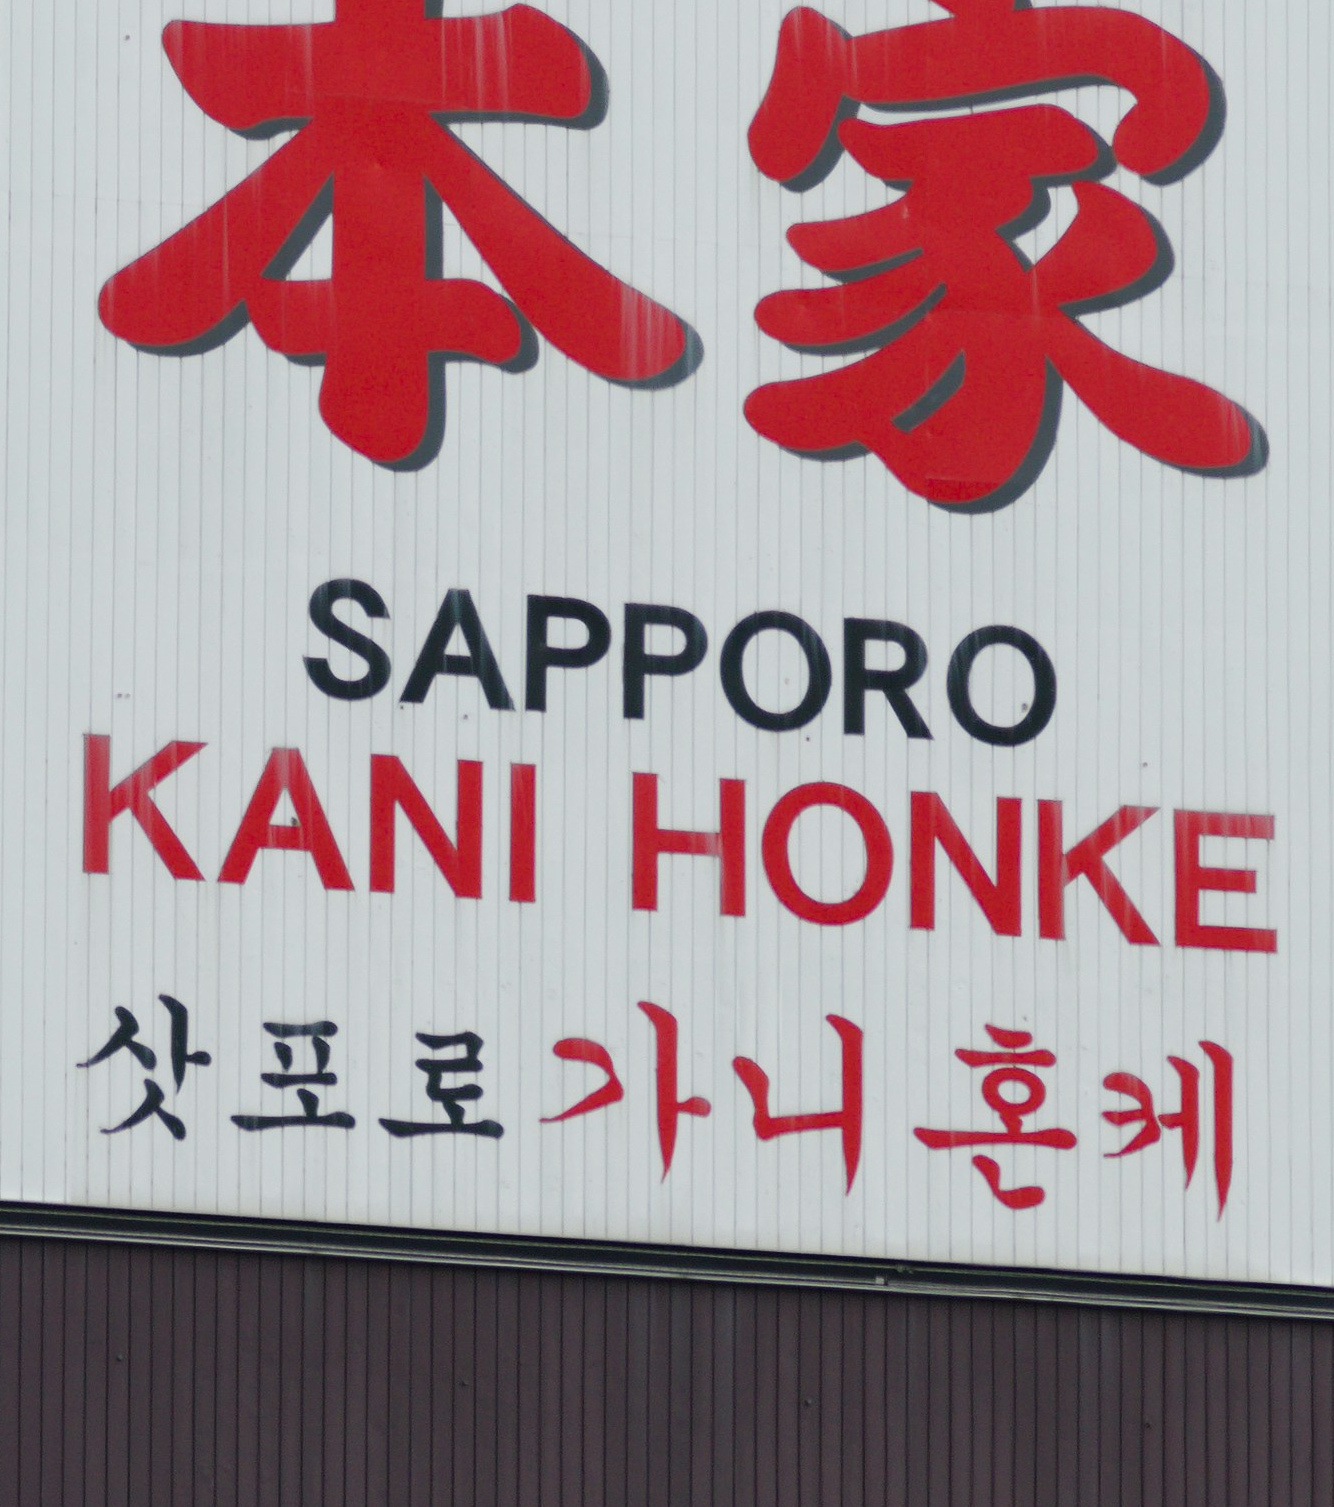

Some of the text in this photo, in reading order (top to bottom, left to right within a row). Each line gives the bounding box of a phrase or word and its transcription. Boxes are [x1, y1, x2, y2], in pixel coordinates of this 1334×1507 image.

[301, 577, 1059, 746] SAPPORO
[82, 732, 1279, 953] KANI HONKE
[76, 994, 505, 1141] 삿포로
